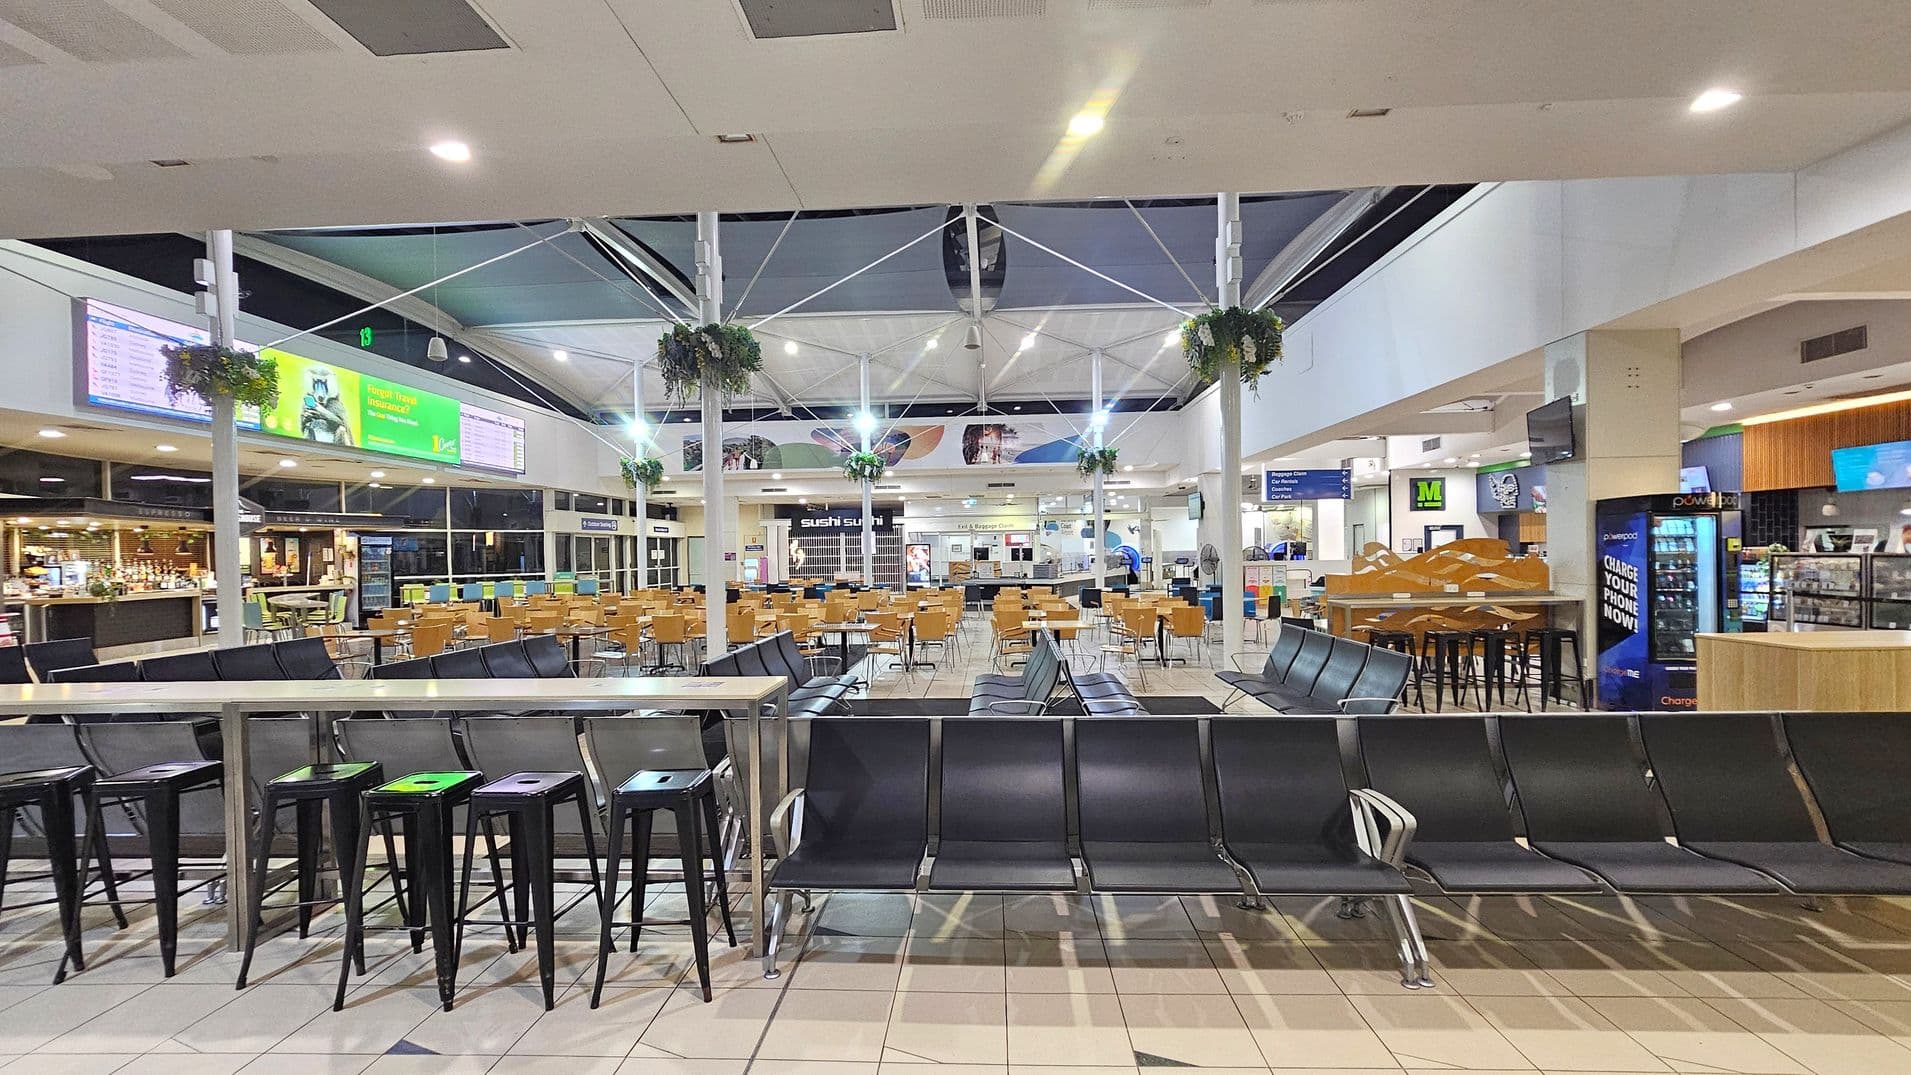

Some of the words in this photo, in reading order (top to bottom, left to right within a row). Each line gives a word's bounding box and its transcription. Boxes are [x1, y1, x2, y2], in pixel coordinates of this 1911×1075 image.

[360, 326, 373, 347] 13
[368, 383, 393, 399] Forgot
[395, 391, 417, 406] Travel
[368, 396, 410, 414] Insurance?
[1417, 480, 1442, 501] M
[276, 515, 301, 523] BEER
[800, 515, 841, 528] sushi
[843, 515, 884, 527] suhi
[1603, 532, 1638, 541] powerpod
[1603, 555, 1638, 582] CHARGE
[1604, 571, 1638, 599] YOUR
[1603, 587, 1639, 616] PHONE
[1603, 603, 1639, 634] NOW!
